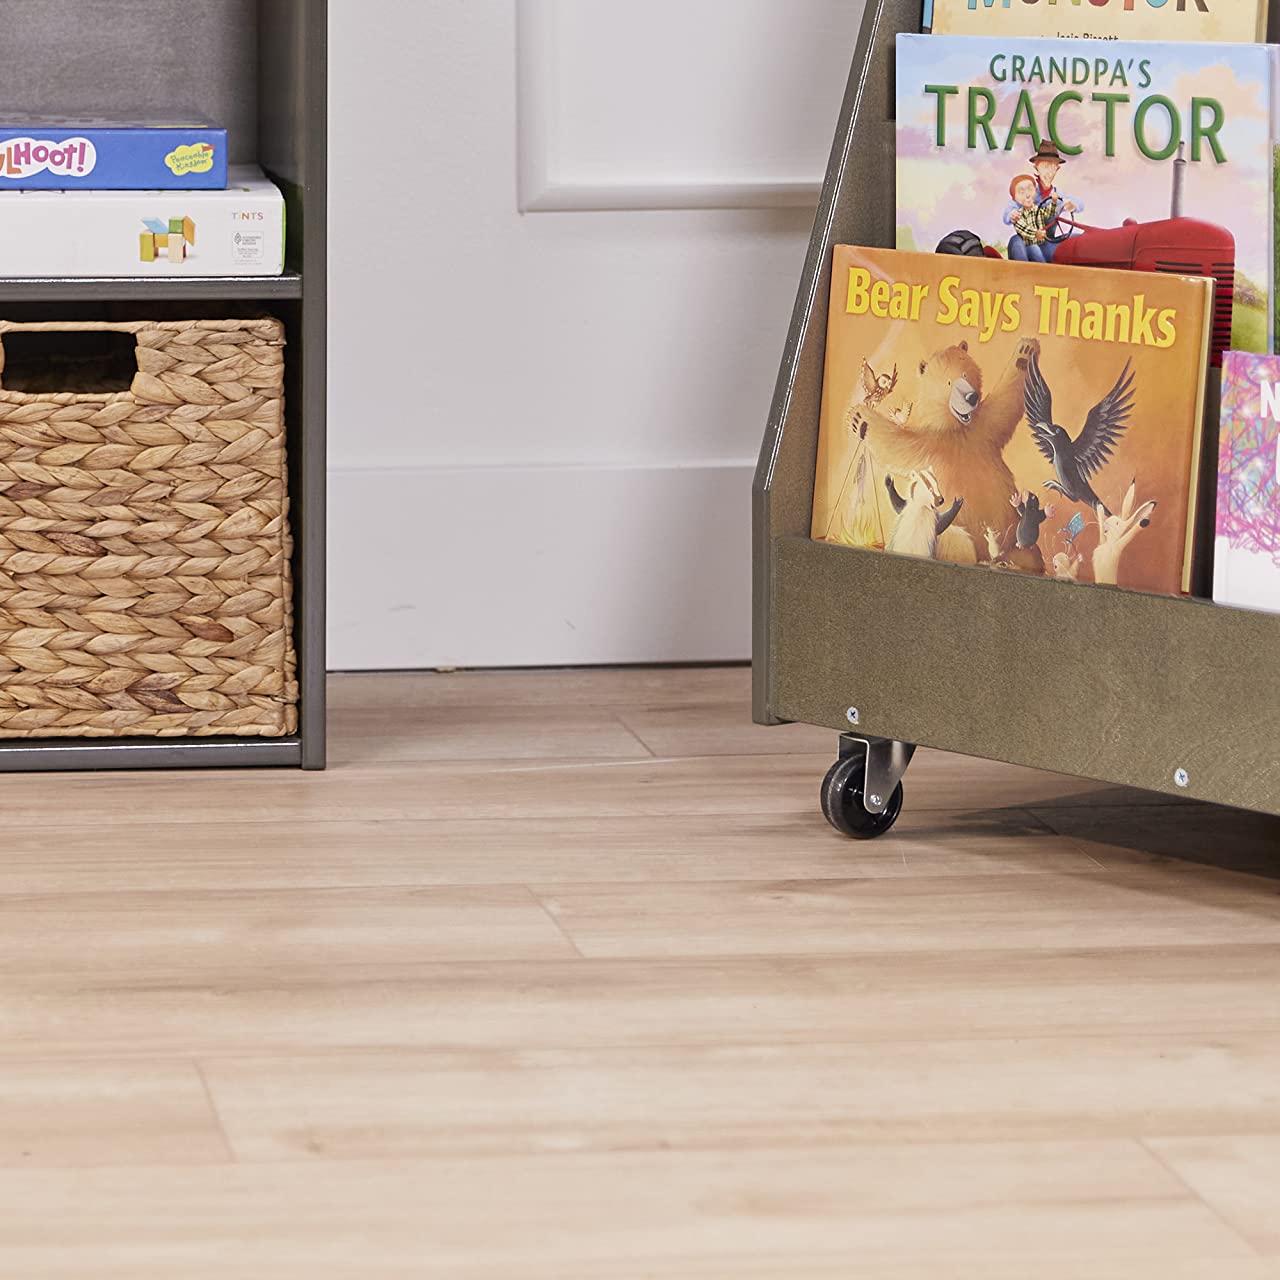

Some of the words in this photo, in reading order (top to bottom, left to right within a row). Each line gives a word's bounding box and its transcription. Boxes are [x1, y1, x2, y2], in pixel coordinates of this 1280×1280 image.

[990, 53, 1152, 88] GRANDPA'S
[924, 84, 1228, 163] TRACTOR
[232, 212, 264, 220] TINTS
[845, 267, 930, 320] Bear
[936, 276, 1020, 343] Says
[1034, 285, 1177, 349] Thanks
